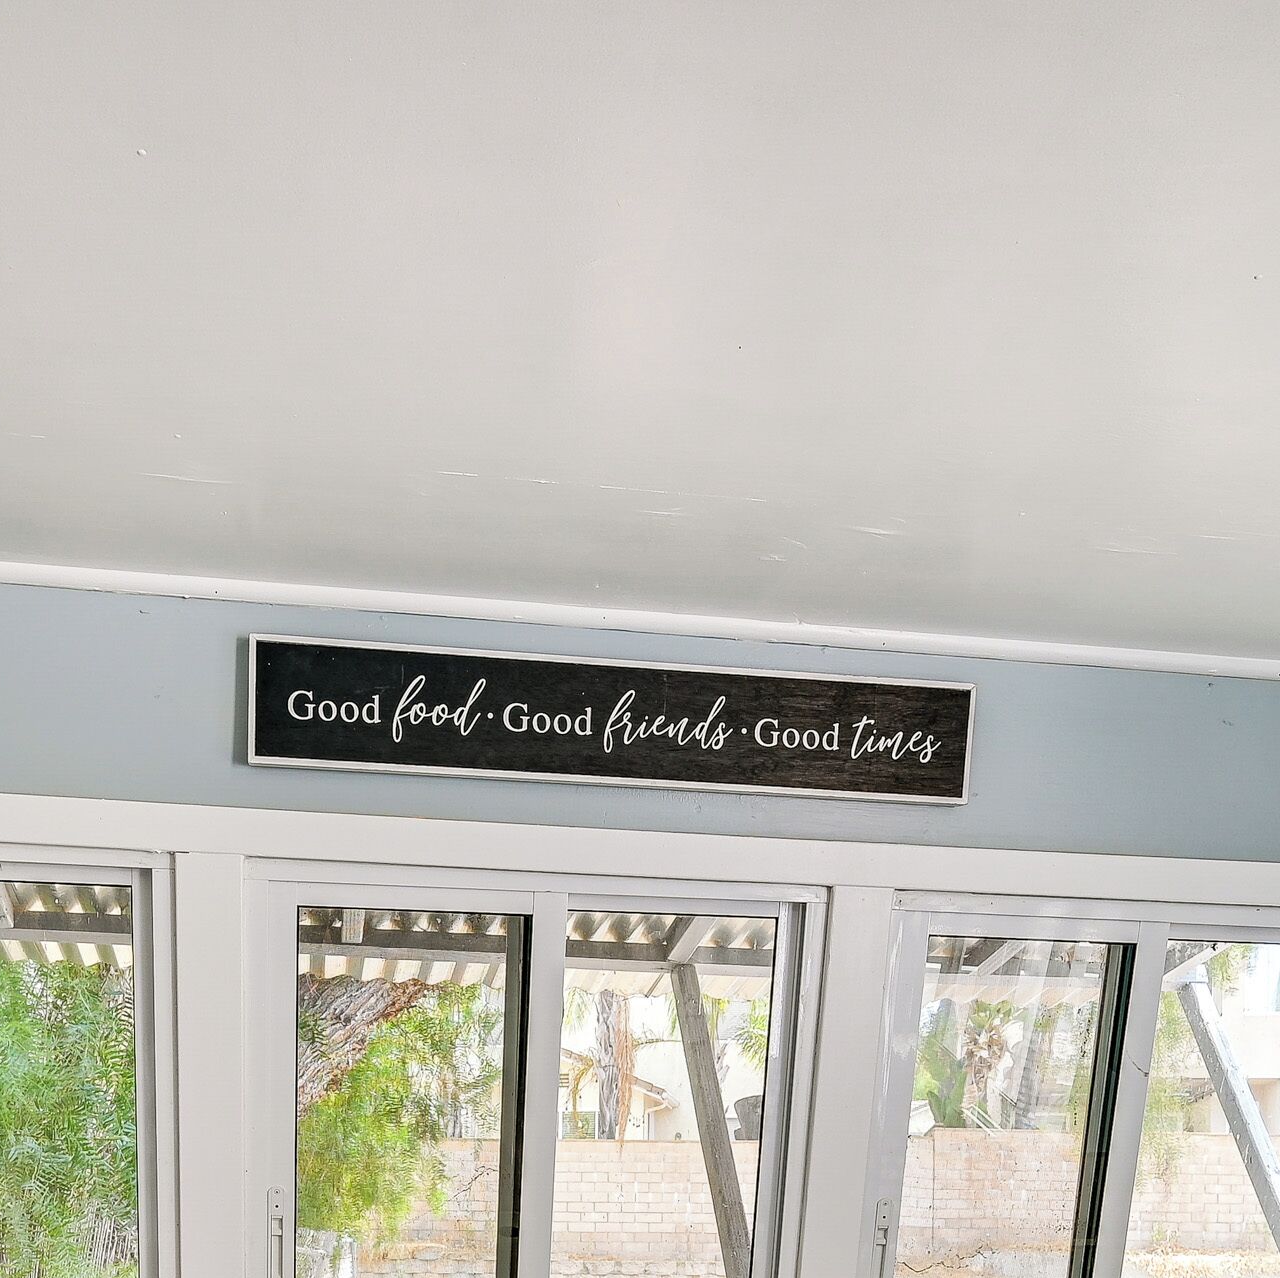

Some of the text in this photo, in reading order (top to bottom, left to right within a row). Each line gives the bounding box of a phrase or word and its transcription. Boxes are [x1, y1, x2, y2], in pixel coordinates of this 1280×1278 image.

[287, 675, 942, 764] Good food Good friends Good times
